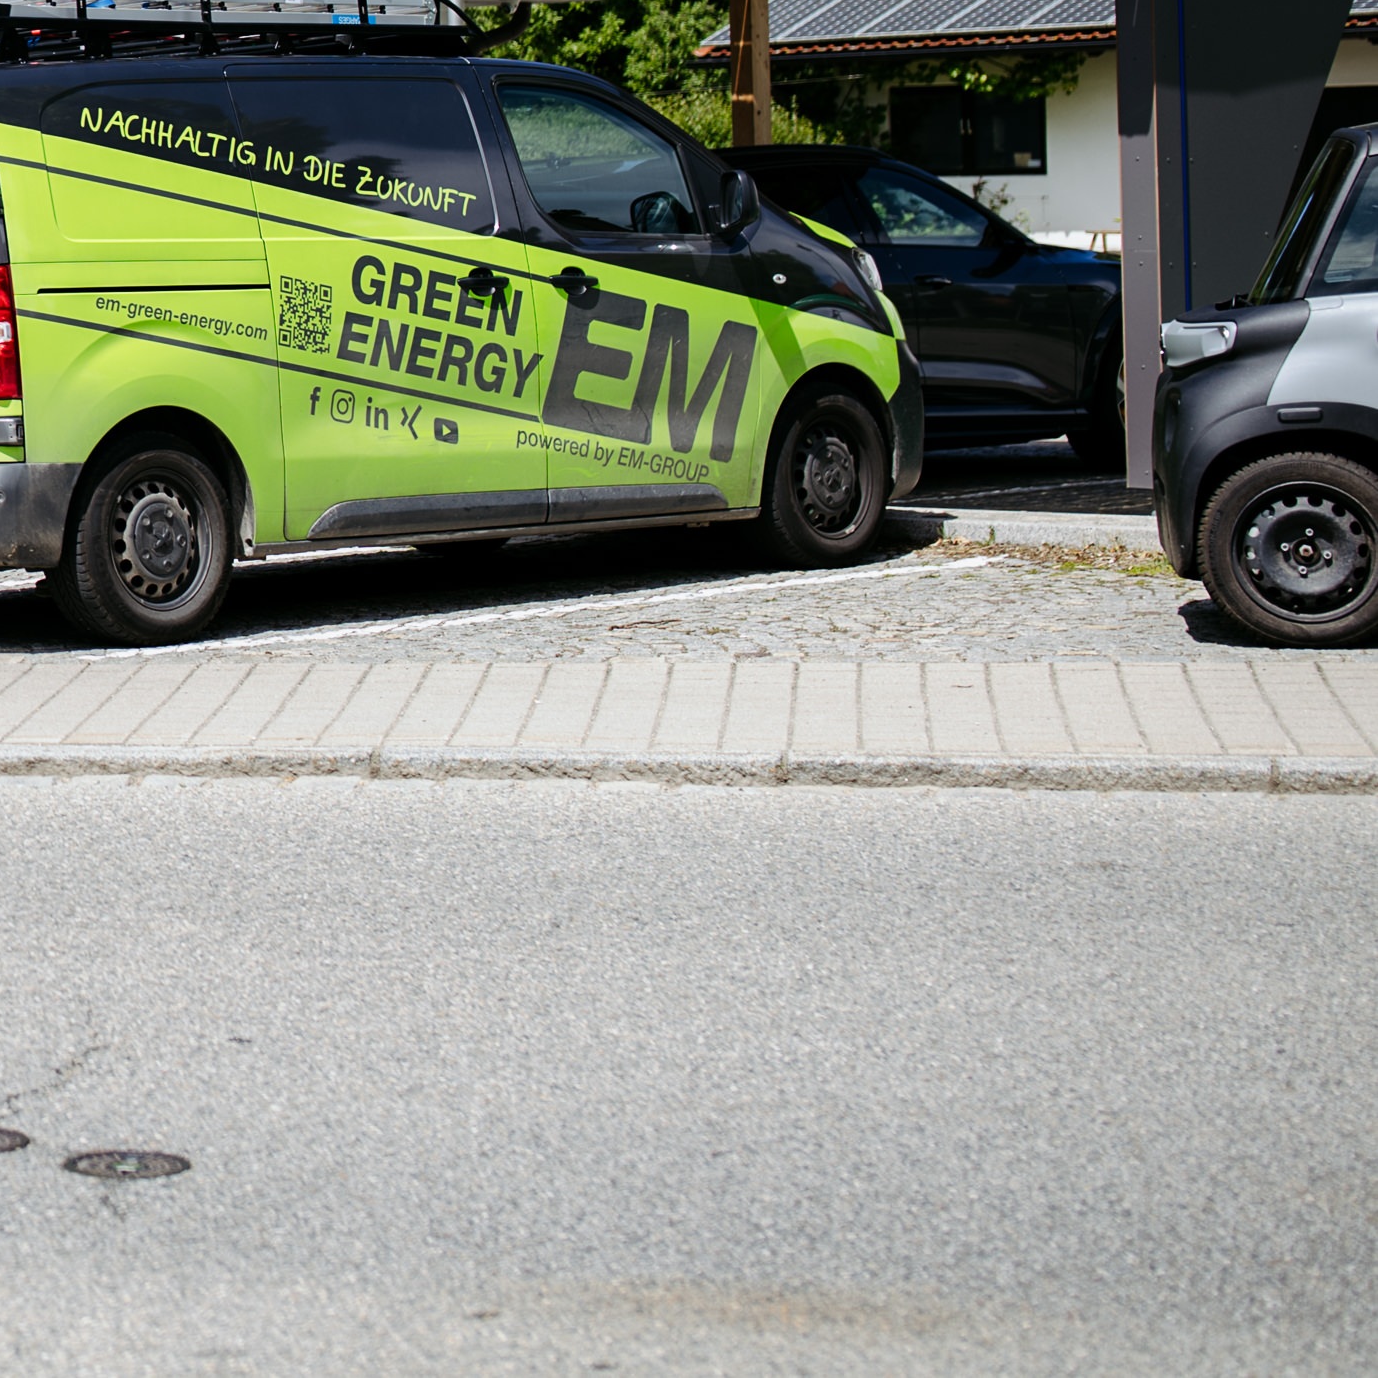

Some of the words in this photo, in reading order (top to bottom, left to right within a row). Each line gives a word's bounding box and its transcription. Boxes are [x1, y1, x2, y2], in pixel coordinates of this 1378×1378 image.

[79, 107, 257, 166] NACHHALTIG
[265, 145, 293, 177] IN
[303, 155, 347, 189] DIE
[355, 165, 477, 217] ZUKUNFT
[95, 295, 268, 341] em-green-energy.com
[351, 255, 523, 337] GREEN
[336, 312, 544, 398] ENERGY
[542, 286, 758, 463] EM
[516, 428, 590, 459] powered
[593, 440, 615, 467] by
[616, 448, 710, 482] EM-GROUP
